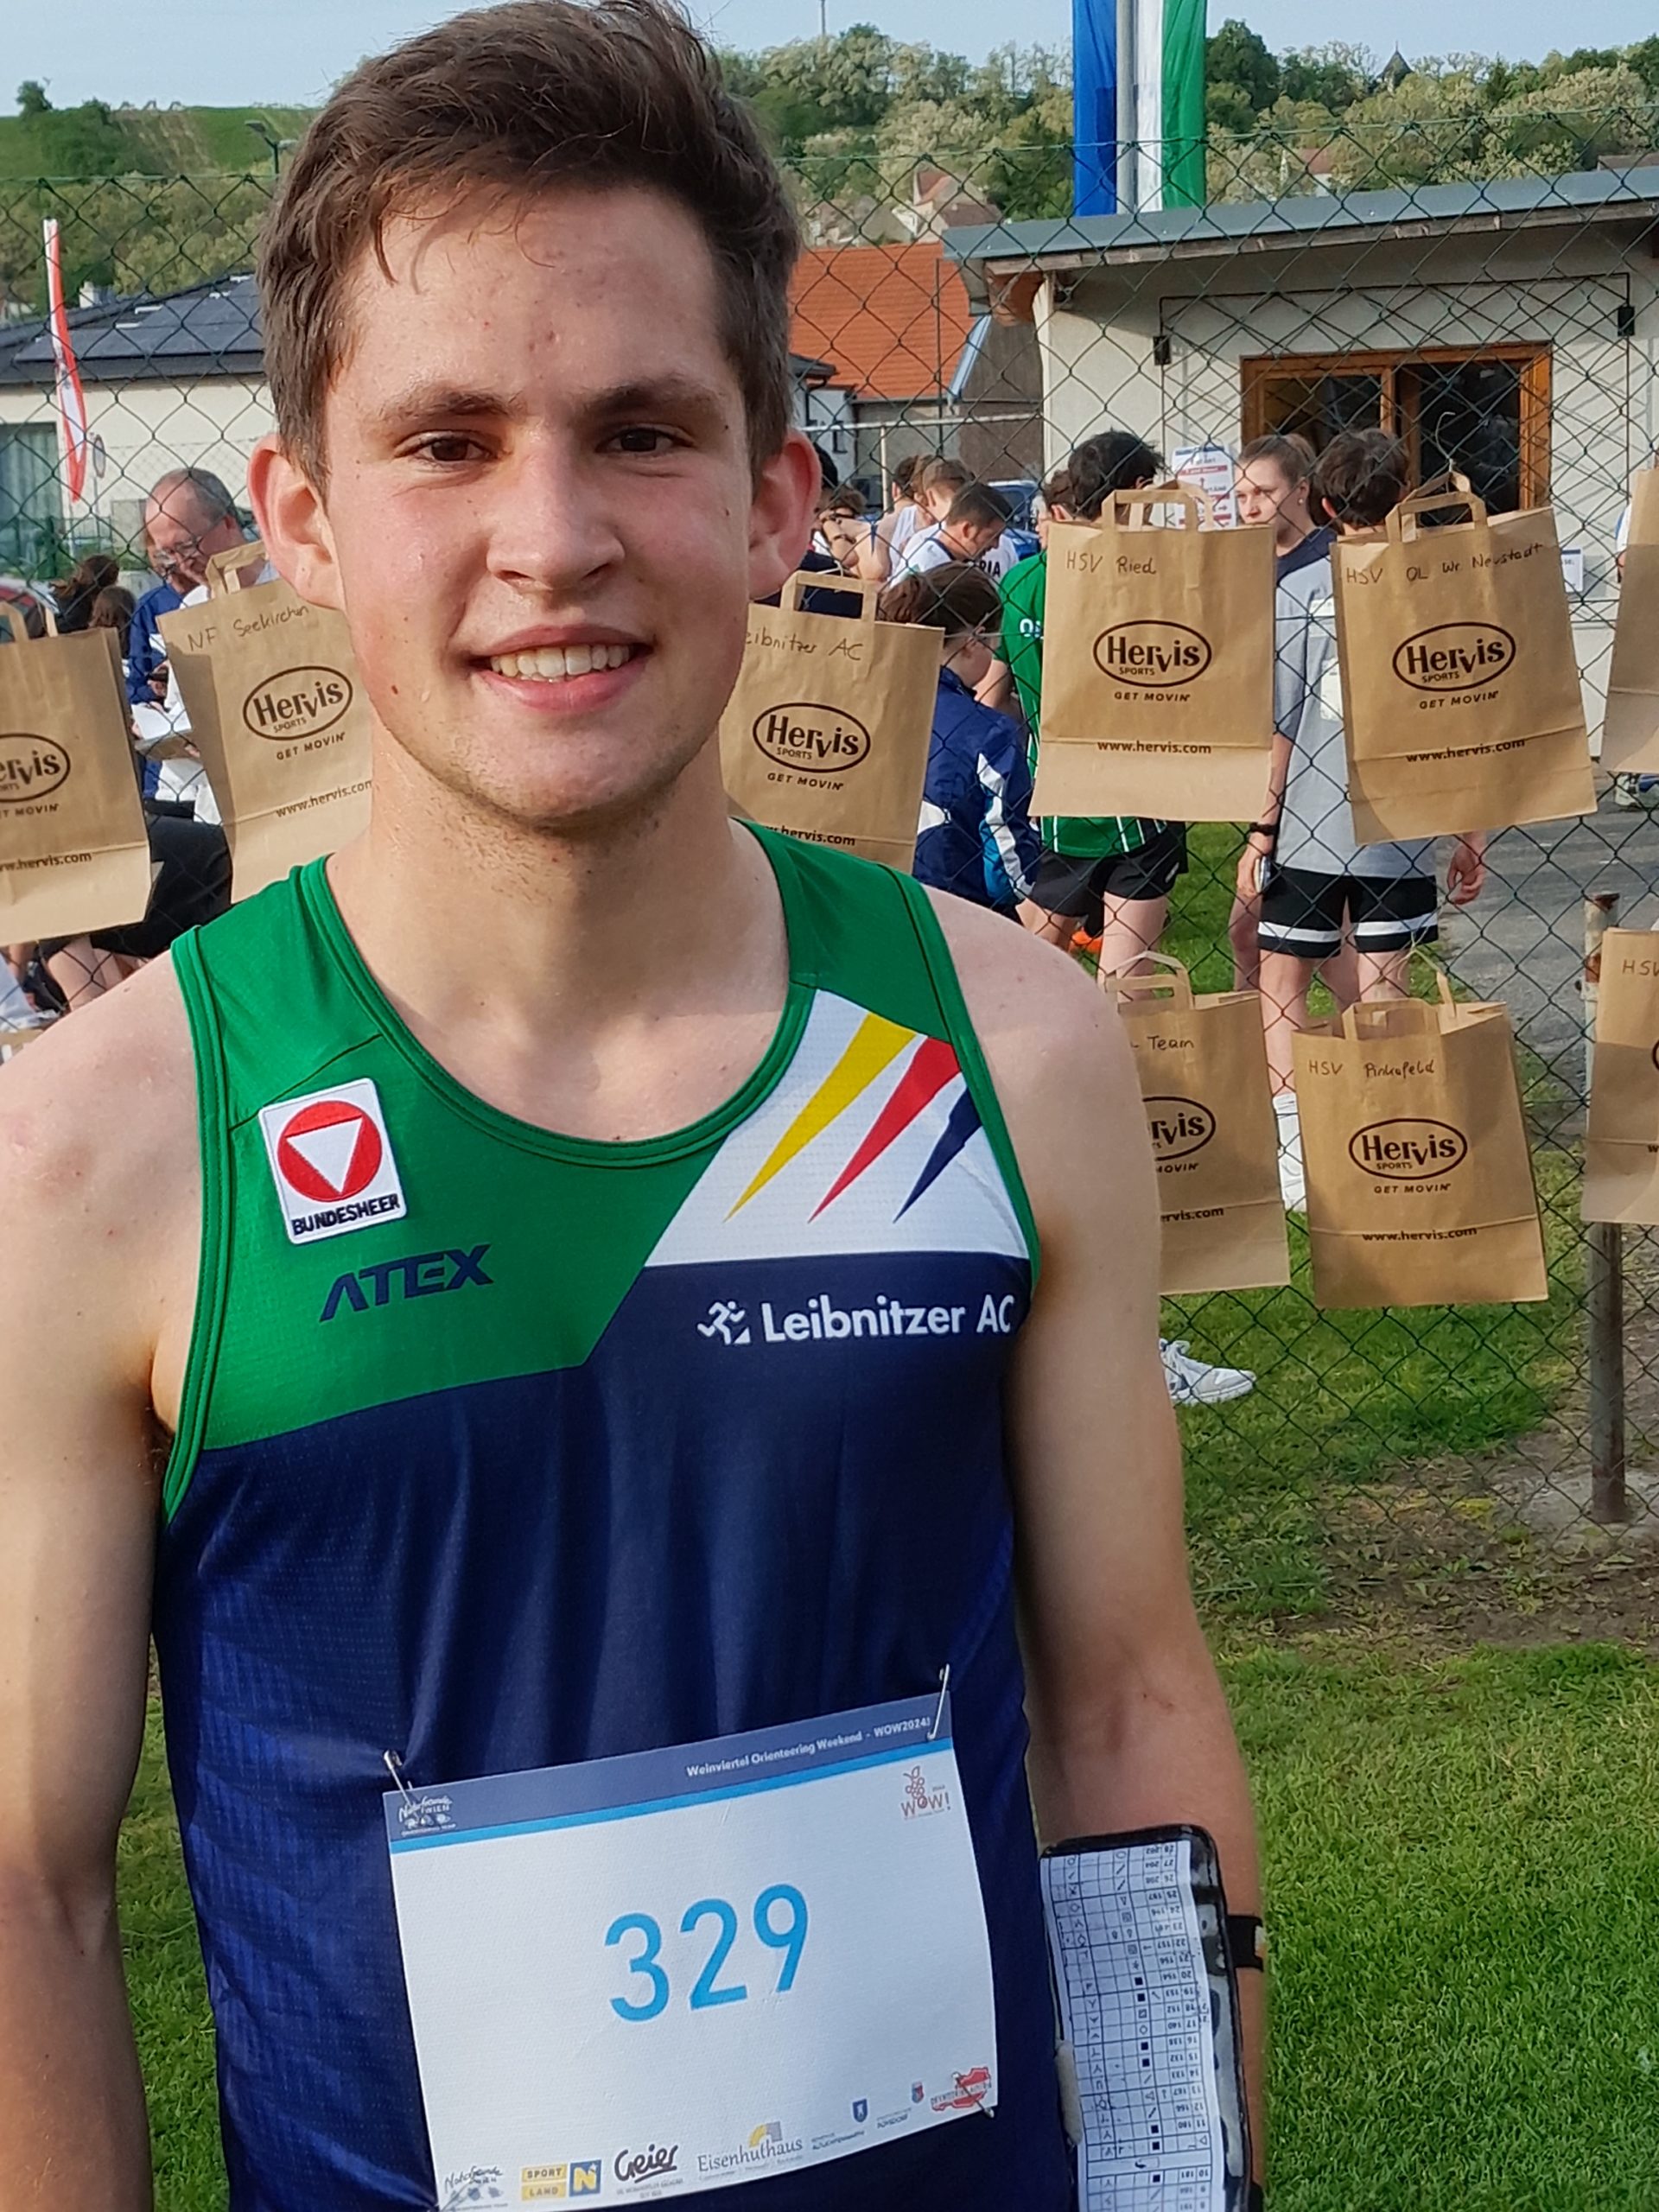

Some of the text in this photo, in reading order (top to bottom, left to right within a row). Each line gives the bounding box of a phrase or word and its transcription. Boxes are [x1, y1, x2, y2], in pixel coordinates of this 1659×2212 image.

[1066, 550, 1157, 575] HSV Ried
[1346, 568, 1382, 585] HSV
[1406, 567, 1428, 582] OL
[188, 626, 217, 651] NF
[828, 637, 864, 661] AC
[1107, 636, 1200, 672] Hervis
[1406, 639, 1505, 675] Hervis
[1119, 667, 1155, 676] SPORTS
[1422, 671, 1460, 683] SPORTS
[1114, 691, 1139, 701] GET
[1420, 698, 1445, 709] GET
[253, 682, 344, 727] Hervis
[273, 718, 307, 733] SPORTS
[766, 714, 860, 759] Hervis
[276, 747, 298, 760] GET
[776, 747, 813, 760] SPORTS
[1097, 741, 1211, 754] www.hervis.com
[1406, 739, 1525, 762] www.hervis.com
[767, 772, 793, 783] GET
[1147, 1035, 1195, 1051] Team
[1309, 1060, 1343, 1075] HSV
[1151, 1112, 1205, 1145] rvis
[1362, 1135, 1456, 1165] Hervis
[1374, 1185, 1399, 1193] GET
[291, 1193, 400, 1236] BUNDESHEER
[1363, 1228, 1478, 1241] www.hervis.com
[319, 1243, 494, 1322] ATEX
[761, 1294, 1014, 1342] Leibnitzer AC
[686, 1755, 748, 1777] Weinviertel
[751, 1744, 815, 1764] Orienteering
[817, 1732, 862, 1749] Weekend
[900, 1792, 950, 1816] WOW!
[1175, 1938, 1185, 1947] 22
[605, 1884, 808, 2022] 329
[1187, 2036, 1197, 2044] 16
[1188, 2052, 1198, 2061] 15
[1192, 2086, 1201, 2094] 13
[614, 2144, 678, 2182] Geier
[526, 2167, 562, 2178] SPORT
[529, 2186, 558, 2196] LAND
